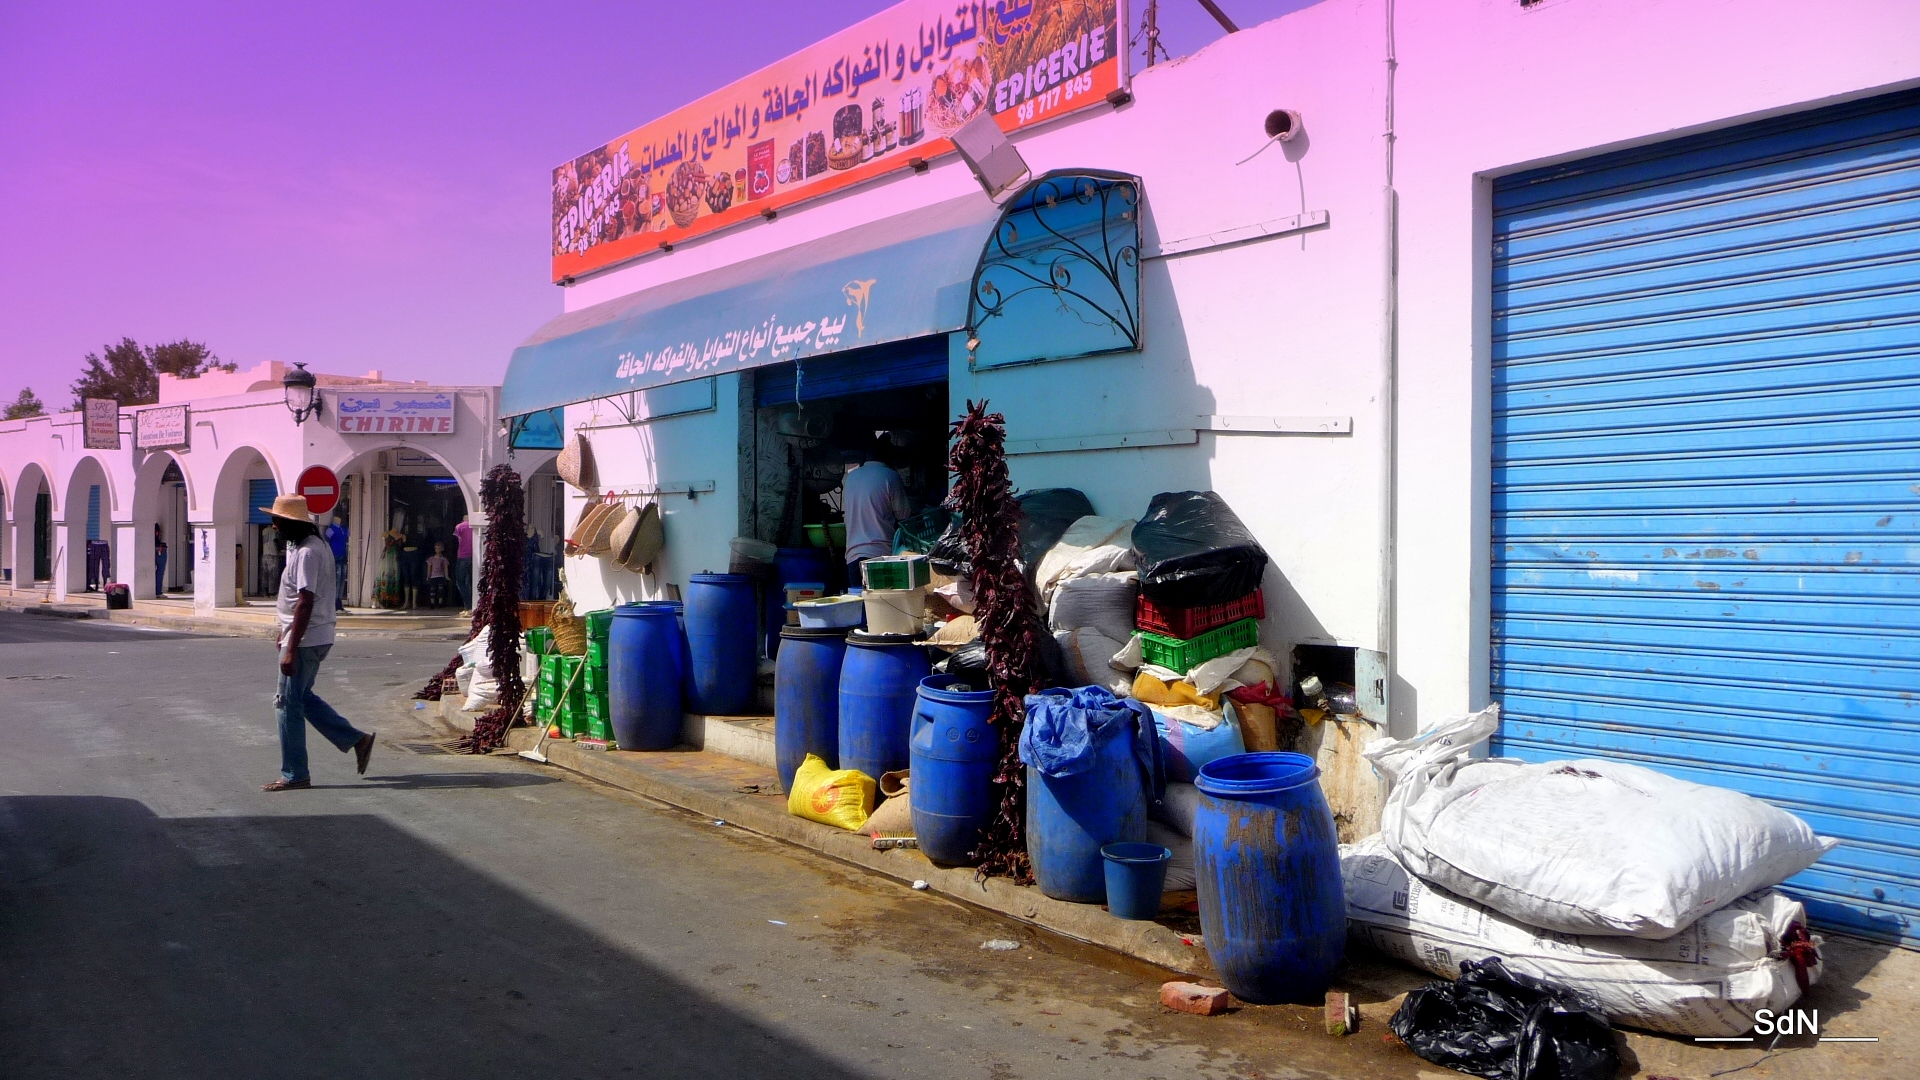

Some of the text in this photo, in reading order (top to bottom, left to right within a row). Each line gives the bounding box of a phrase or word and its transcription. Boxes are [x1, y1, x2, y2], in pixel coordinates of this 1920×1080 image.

[910, 0, 987, 72] التوابل
[993, 0, 1033, 46] بيع
[822, 38, 888, 98] الفواكه
[892, 43, 905, 81] و
[994, 25, 1105, 113] EPICERIE
[762, 69, 817, 122] الجافة
[1017, 72, 1093, 124] 98 717 845
[701, 101, 746, 161] الموالح
[748, 107, 760, 138] و
[690, 133, 699, 163] و
[559, 139, 629, 249] EPICERIE
[577, 193, 620, 257] 98 717 845
[698, 329, 741, 371] التوابل
[739, 314, 776, 362] أنواع
[772, 321, 816, 357] جميع
[815, 314, 846, 349] بيع
[616, 349, 653, 384] الجافة
[340, 416, 451, 432] CHIRINE
